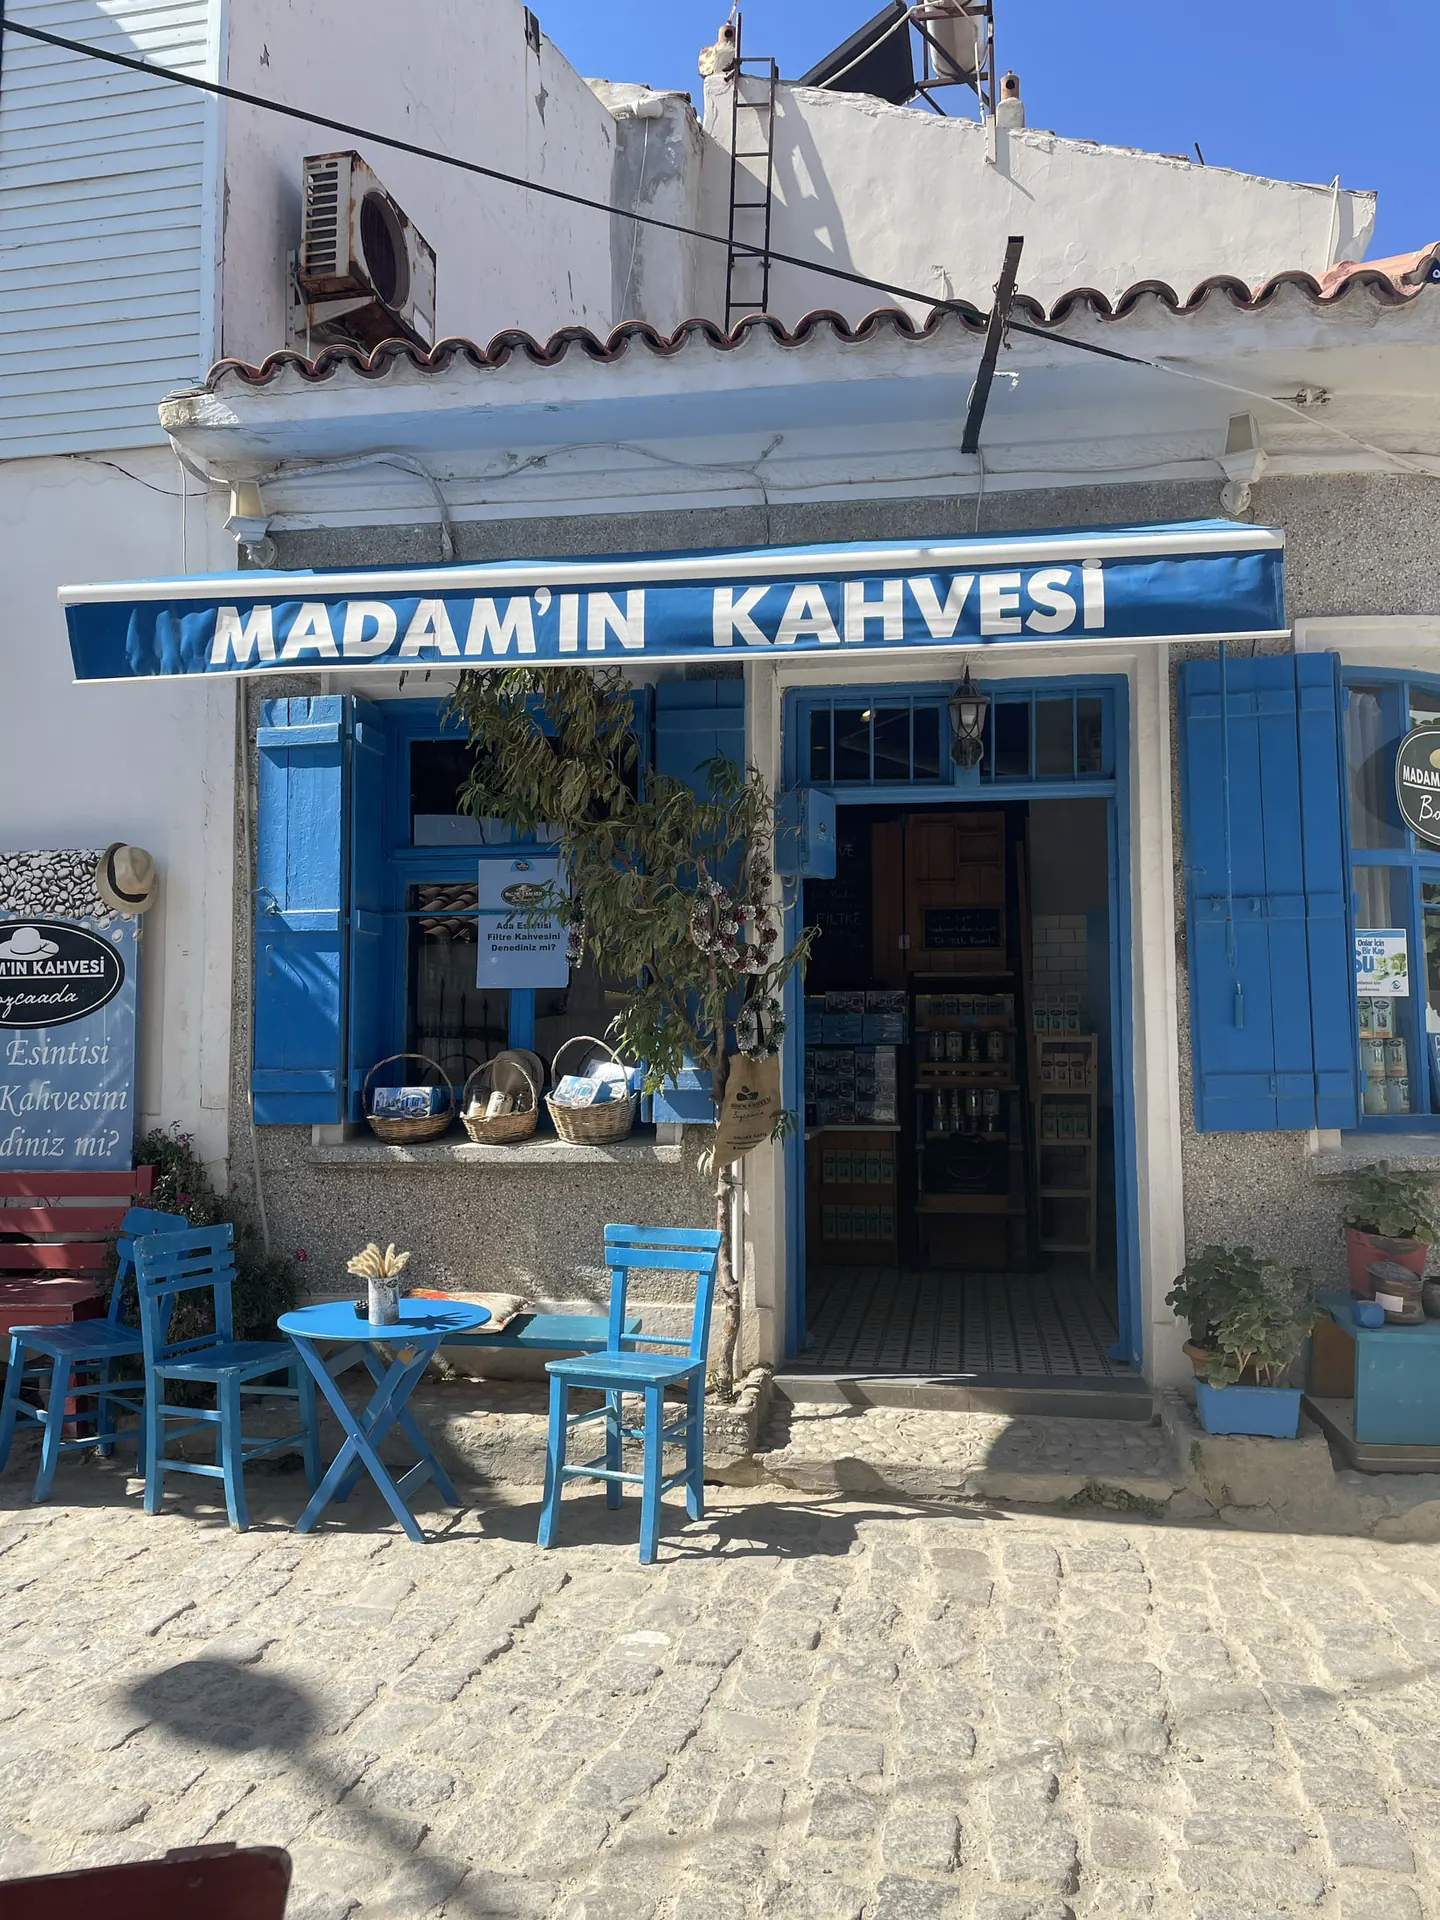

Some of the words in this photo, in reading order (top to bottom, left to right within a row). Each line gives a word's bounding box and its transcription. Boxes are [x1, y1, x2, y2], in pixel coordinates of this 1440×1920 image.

[712, 558, 1106, 648] KAHVESİ
[487, 933, 512, 941] Filtre
[515, 932, 561, 941] Kahvesini
[496, 922, 514, 930] Ada
[491, 944, 537, 952] Denediniz
[539, 943, 556, 951] mi?
[33, 956, 104, 975] KAHVESİ
[7, 1037, 110, 1066] Esintisi
[0, 1081, 129, 1117] Kahvesini
[74, 1129, 120, 1157] mi?
